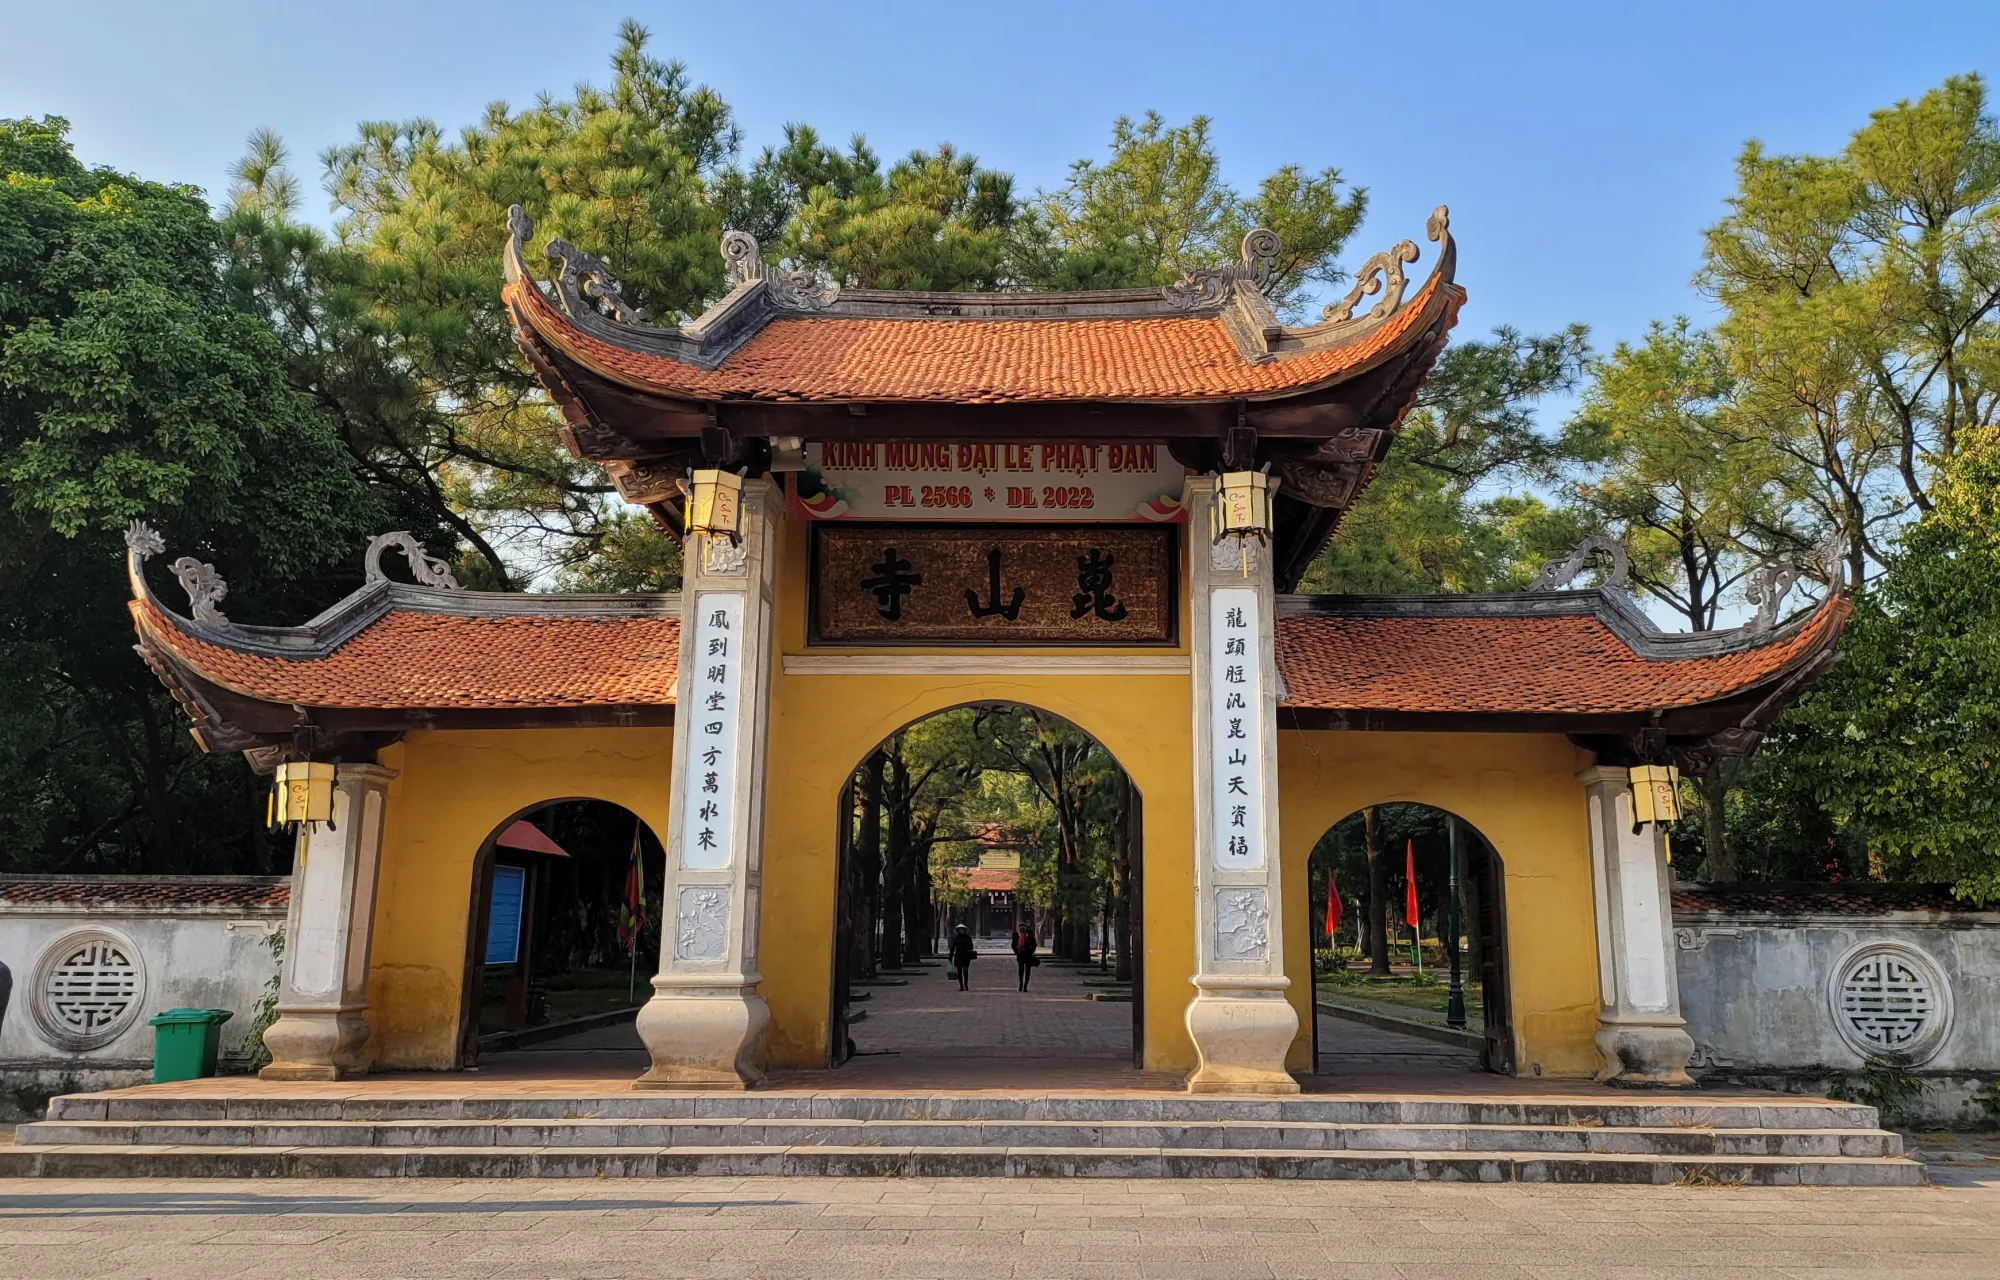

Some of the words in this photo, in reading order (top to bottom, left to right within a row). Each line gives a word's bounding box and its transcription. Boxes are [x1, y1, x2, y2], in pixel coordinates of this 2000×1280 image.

[884, 485, 916, 507] PL
[920, 485, 973, 508] 2566
[1006, 487, 1038, 508] DL
[1043, 486, 1095, 508] 2022
